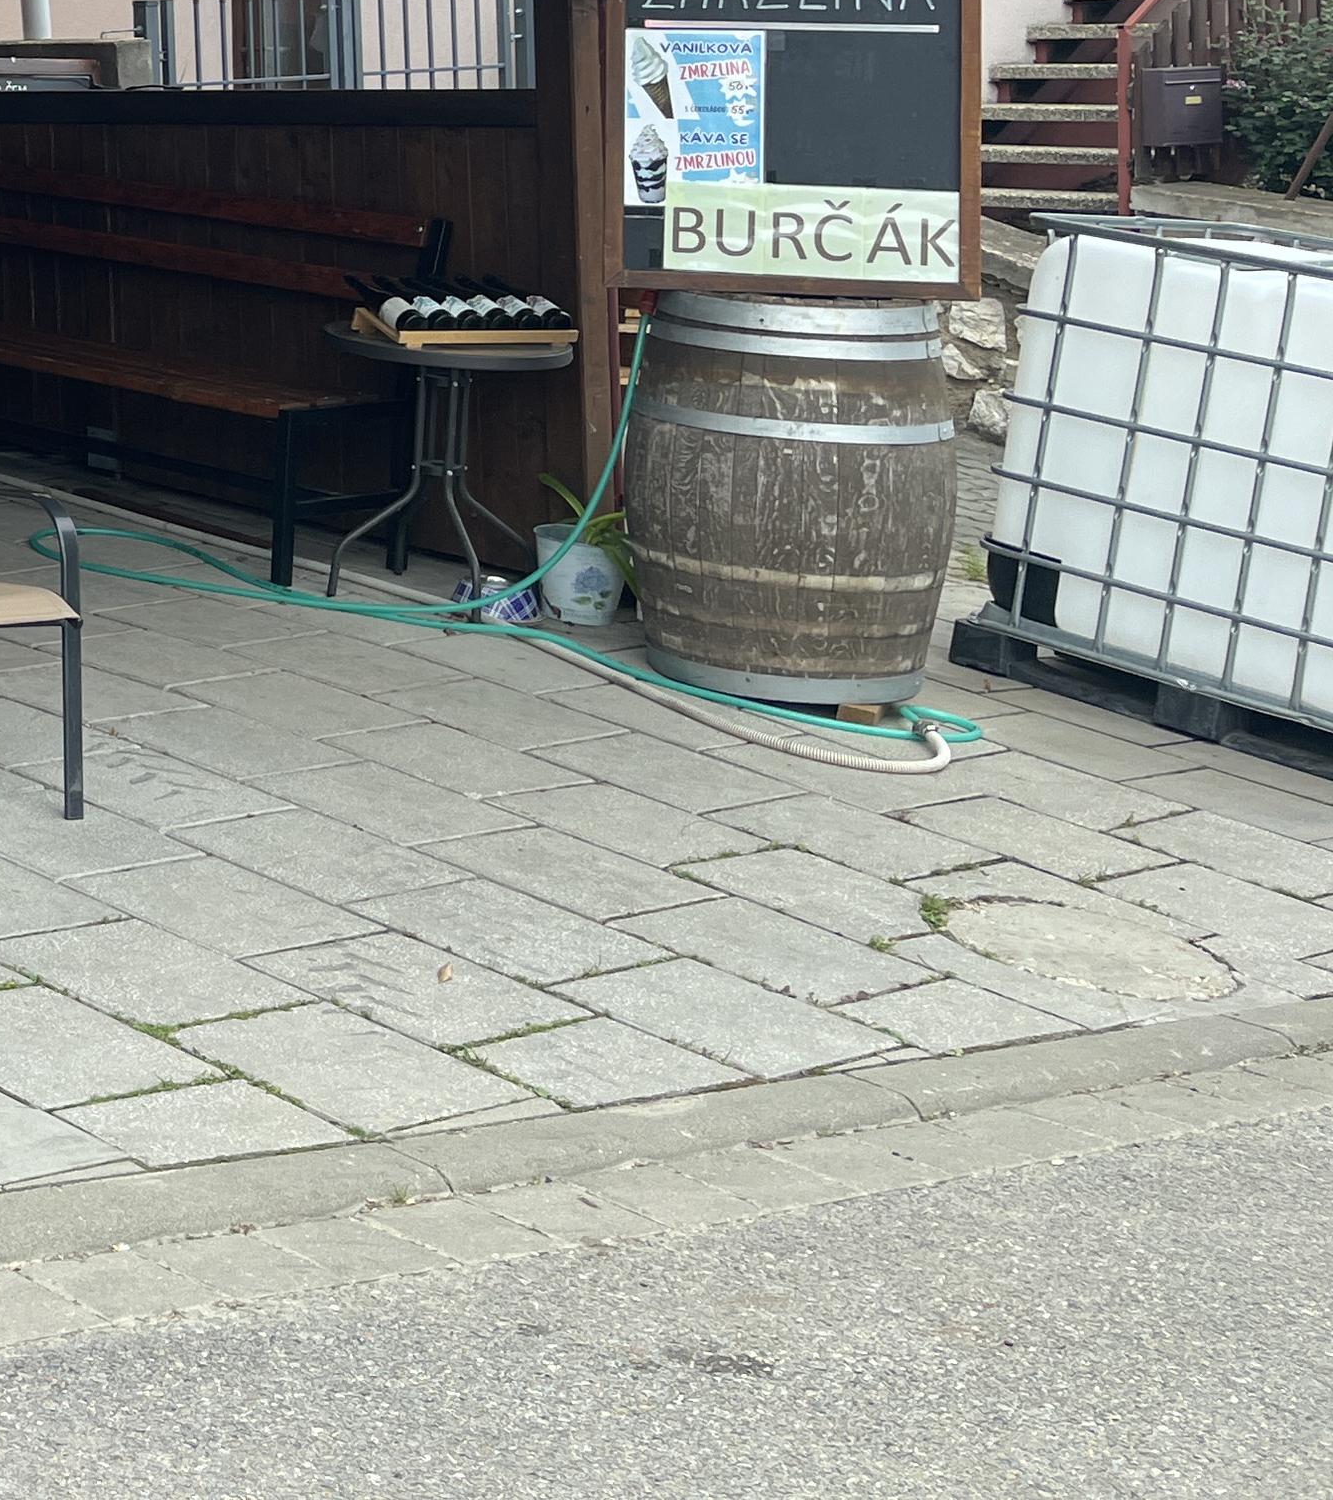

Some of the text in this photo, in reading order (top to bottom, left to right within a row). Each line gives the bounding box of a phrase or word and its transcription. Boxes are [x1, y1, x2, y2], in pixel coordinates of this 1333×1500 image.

[679, 60, 751, 80] ZMRZLINA
[679, 128, 748, 145] KÁVA SE
[675, 150, 755, 171] ZMRZLINOU
[670, 199, 958, 270] BURČÁK
